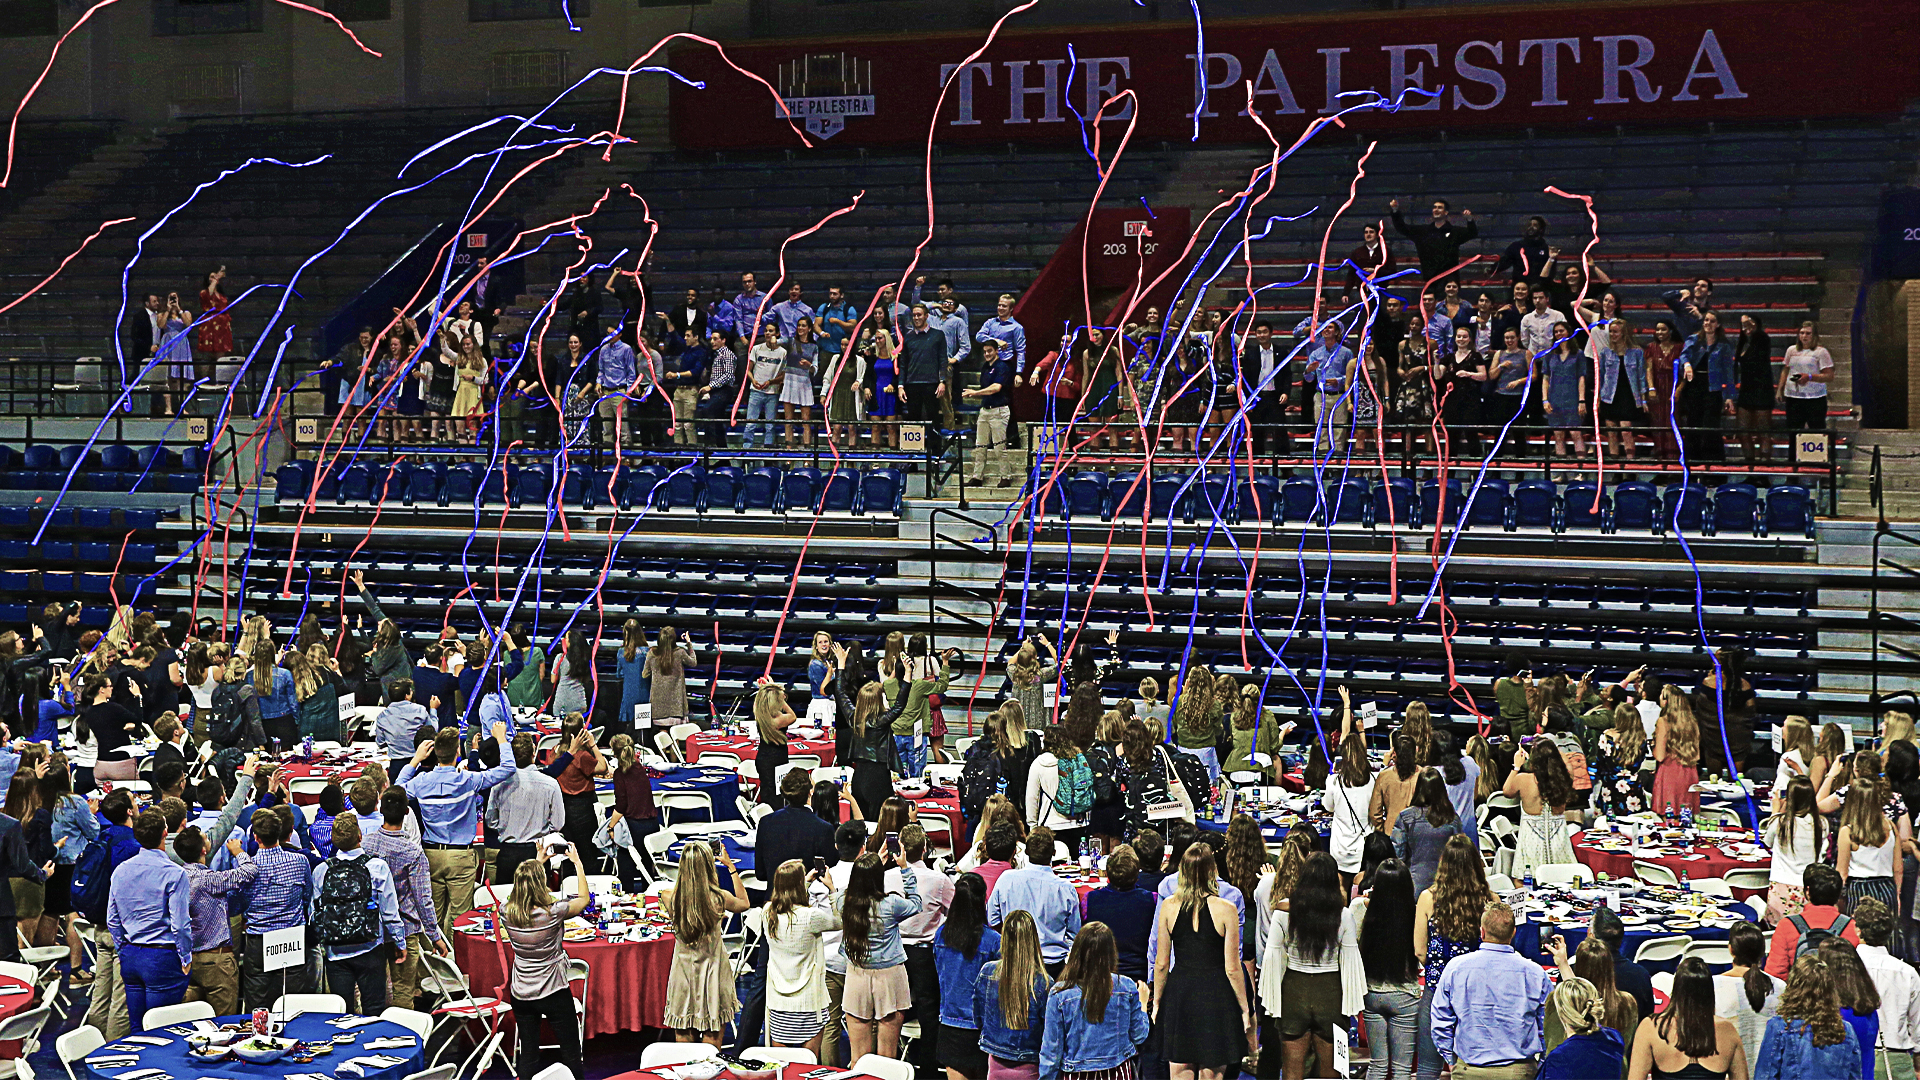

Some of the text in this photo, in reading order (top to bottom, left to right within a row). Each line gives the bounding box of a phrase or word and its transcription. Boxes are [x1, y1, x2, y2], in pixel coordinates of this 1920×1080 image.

[940, 28, 1748, 126] THE PALESTRA
[809, 98, 868, 114] PALESTRA
[1103, 243, 1127, 255] 203
[190, 425, 205, 434] 102
[299, 425, 314, 434] 103
[902, 431, 921, 442] 103
[1801, 441, 1825, 452] 104
[266, 940, 302, 957] FOOTBALL
